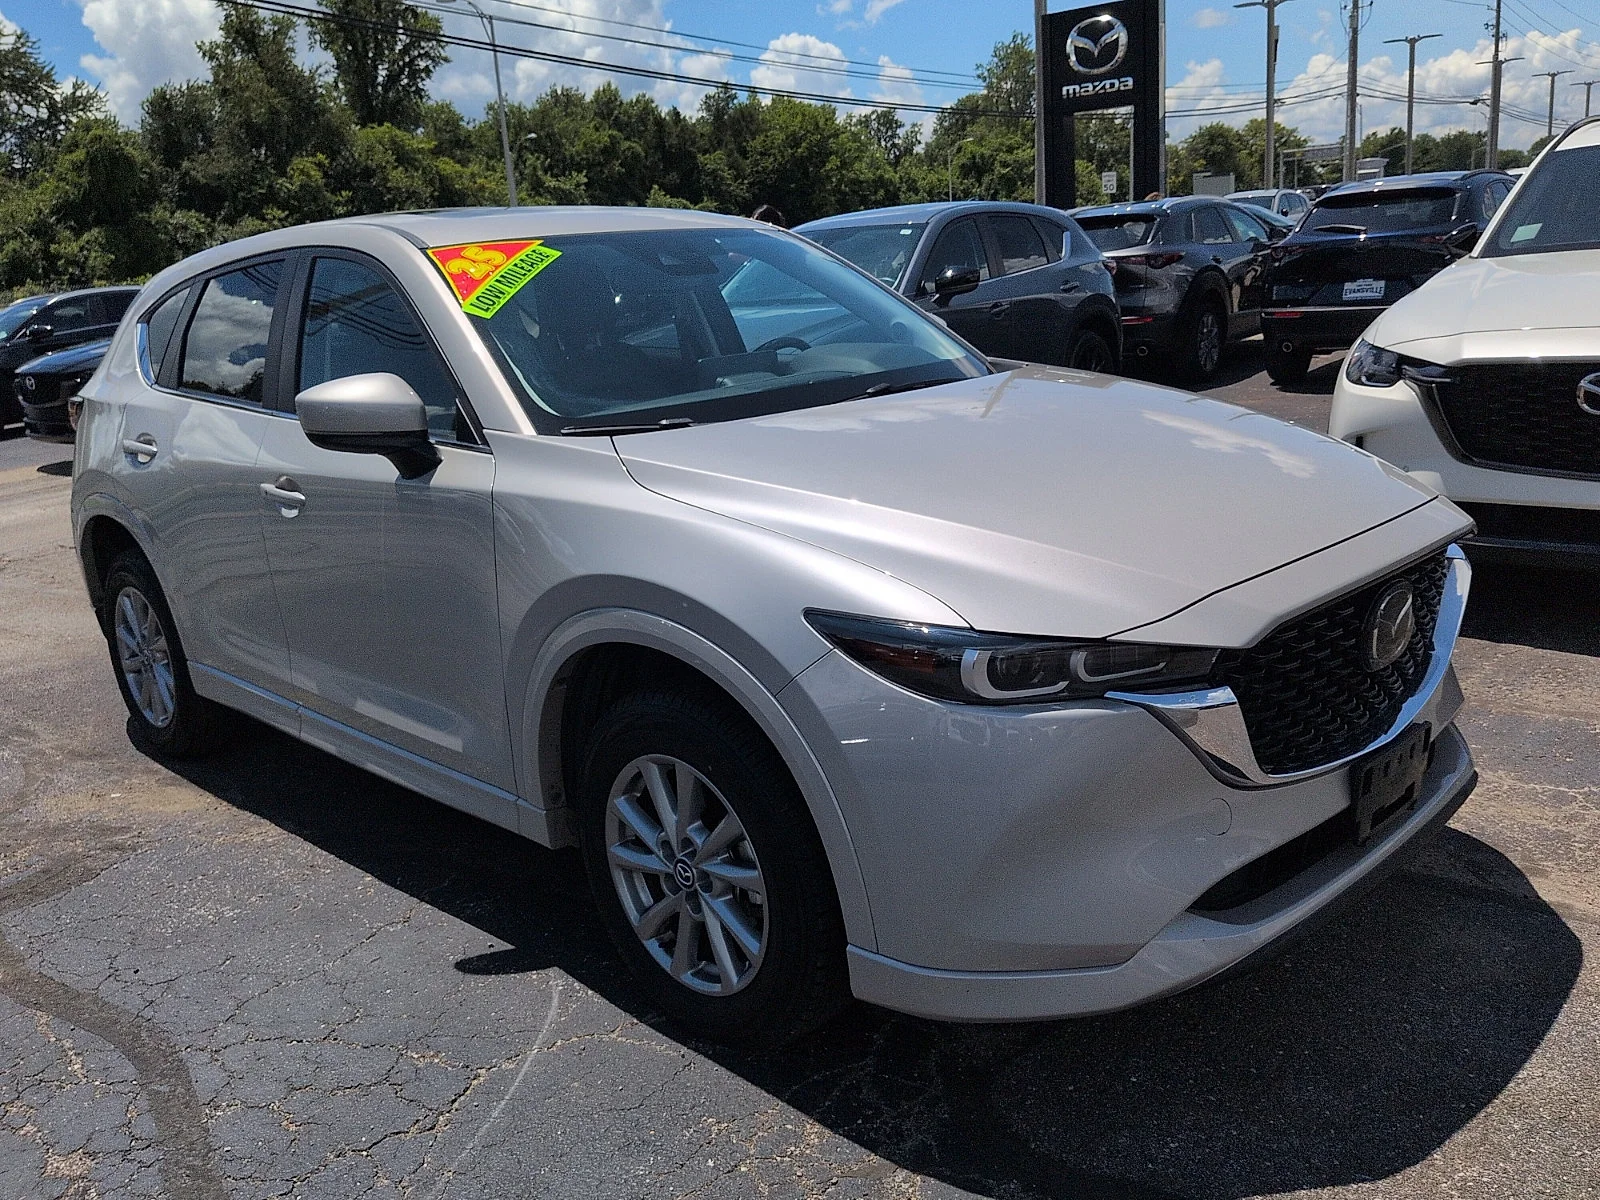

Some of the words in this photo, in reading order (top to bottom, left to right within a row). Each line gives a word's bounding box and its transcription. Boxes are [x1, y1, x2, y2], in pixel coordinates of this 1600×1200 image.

[1062, 77, 1134, 98] mazda
[1103, 184, 1115, 192] 50
[446, 246, 507, 280] 25
[470, 278, 506, 312] LOW
[499, 249, 550, 289] MILEAGE
[1344, 286, 1384, 295] EVANSVILLE
